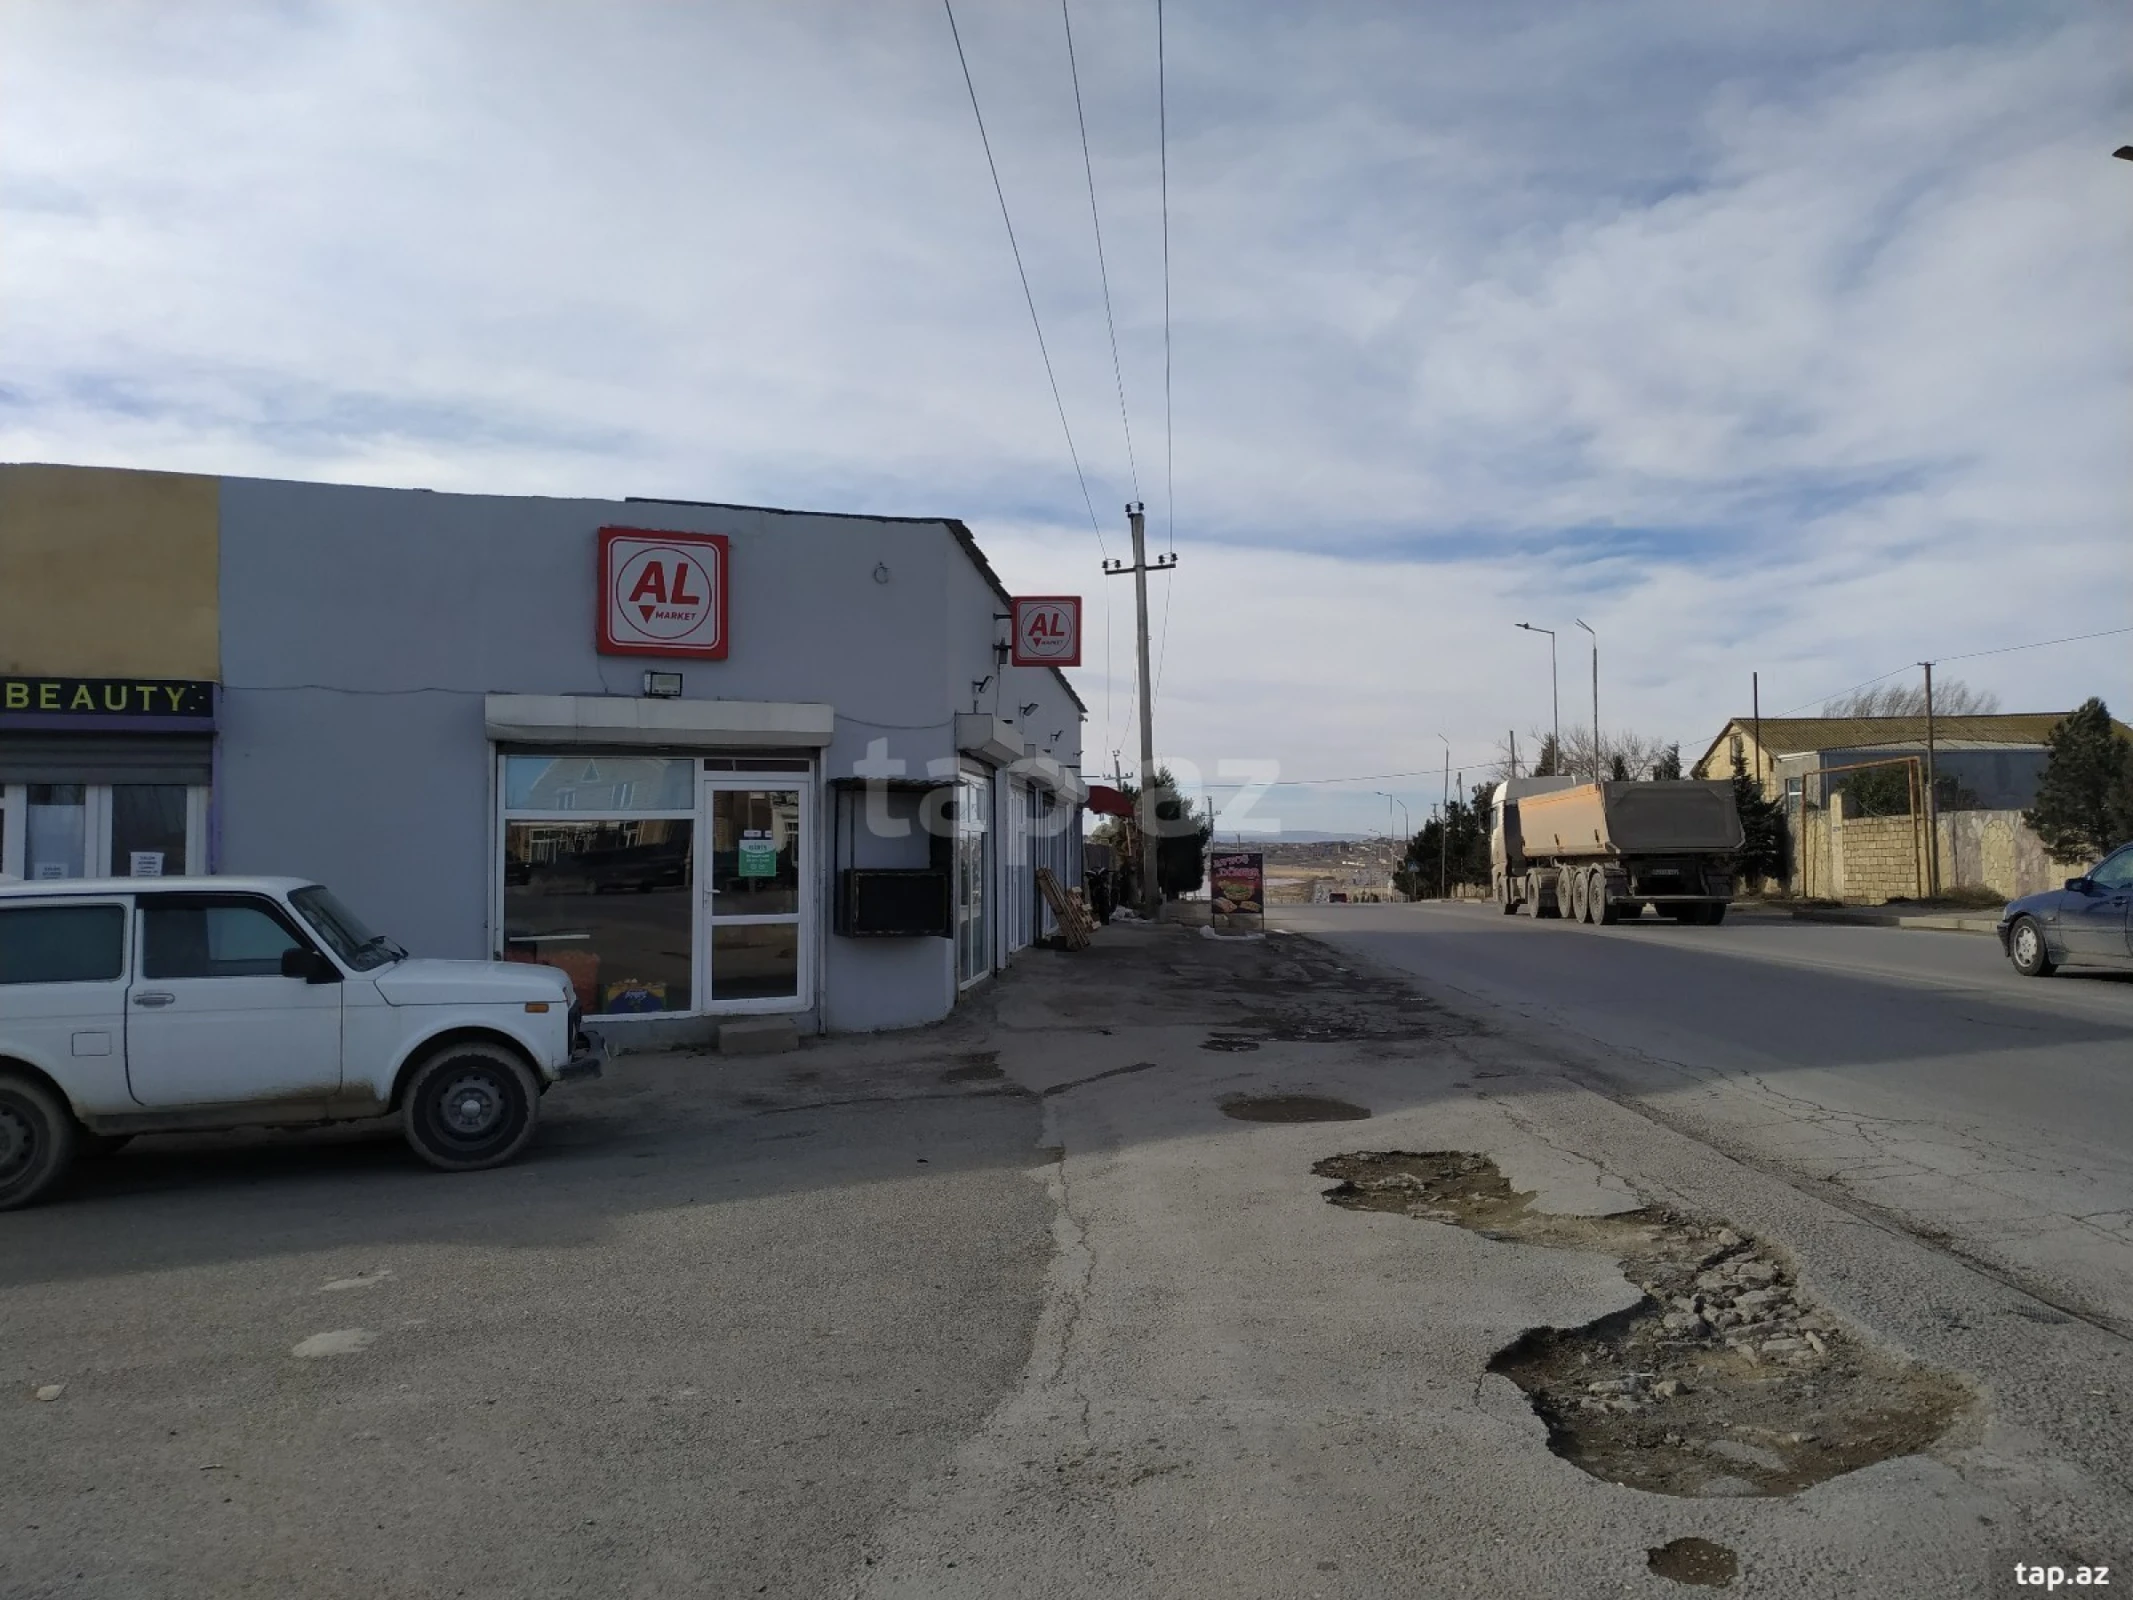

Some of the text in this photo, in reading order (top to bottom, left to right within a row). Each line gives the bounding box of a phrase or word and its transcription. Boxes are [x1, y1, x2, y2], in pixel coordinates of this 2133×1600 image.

[629, 561, 701, 605] AL
[655, 611, 697, 621] MARKET
[1028, 613, 1065, 637] AL
[5, 682, 186, 712] BEAUTY
